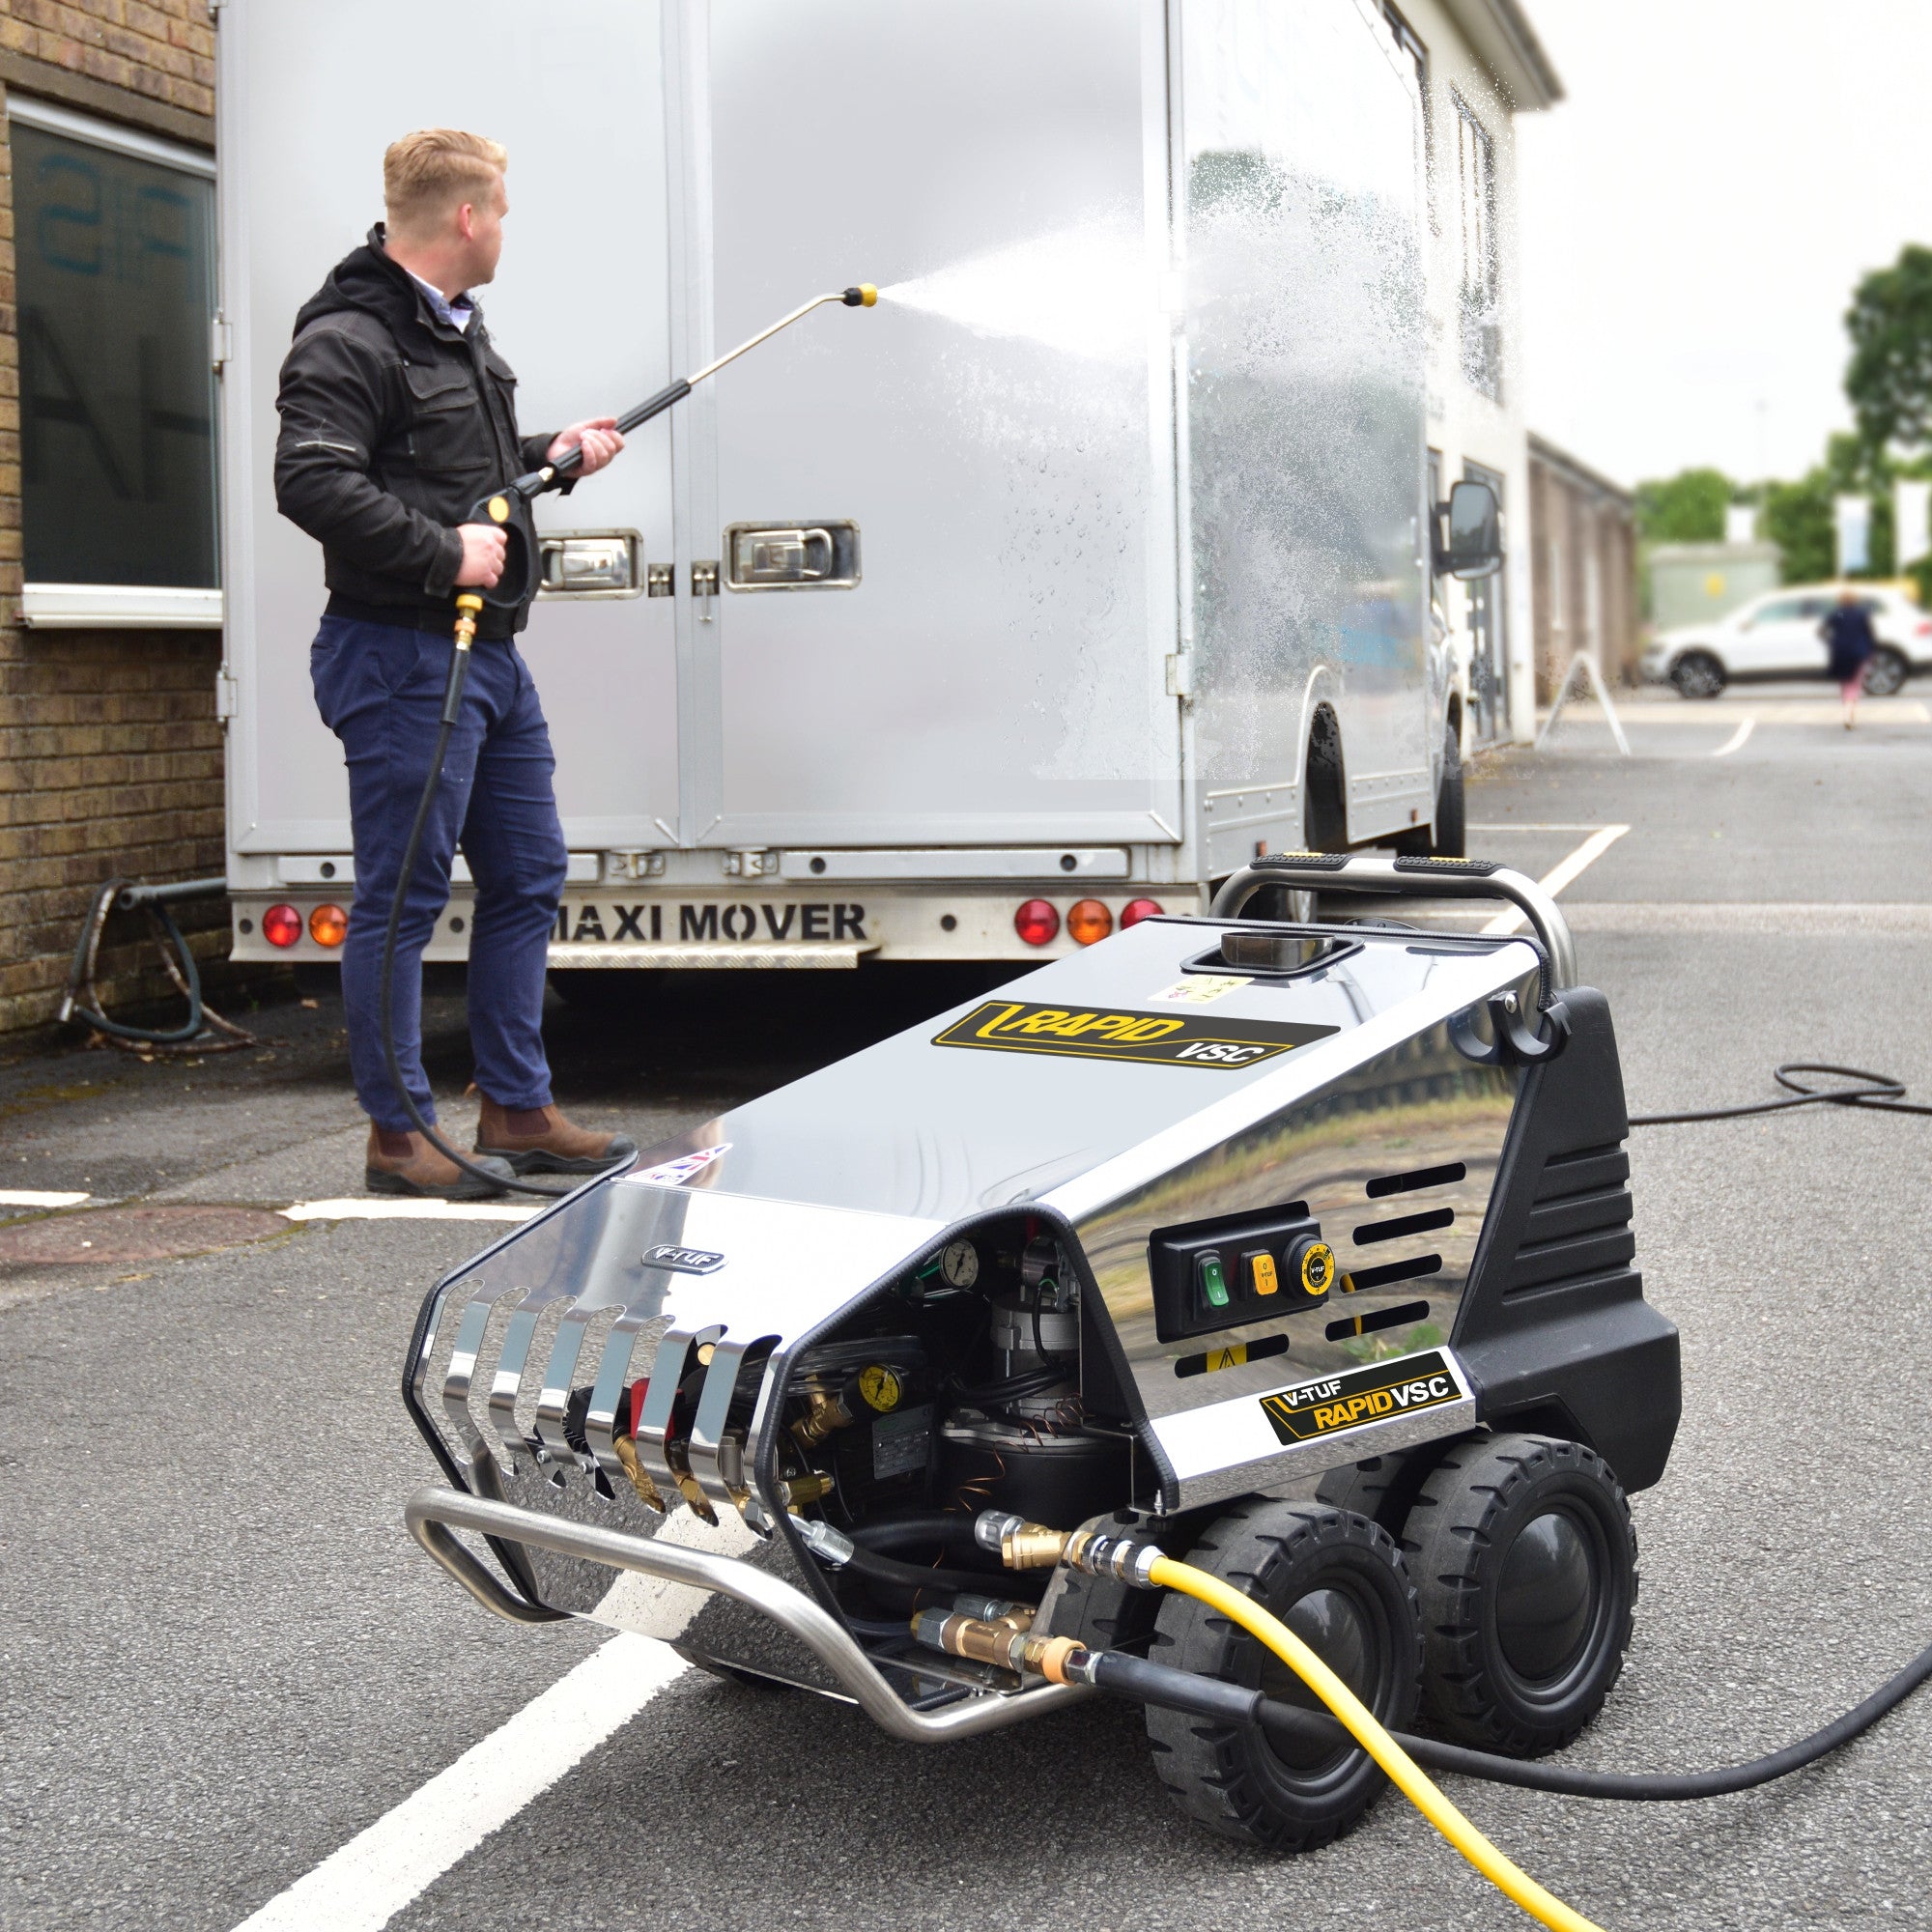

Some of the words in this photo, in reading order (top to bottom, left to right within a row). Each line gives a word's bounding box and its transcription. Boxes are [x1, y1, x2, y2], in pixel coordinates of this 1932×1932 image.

[679, 904, 867, 941] MOVER
[998, 1009, 1185, 1042] RAPID
[1175, 1042, 1264, 1063] VSC
[1283, 1379, 1342, 1406] V-TUF
